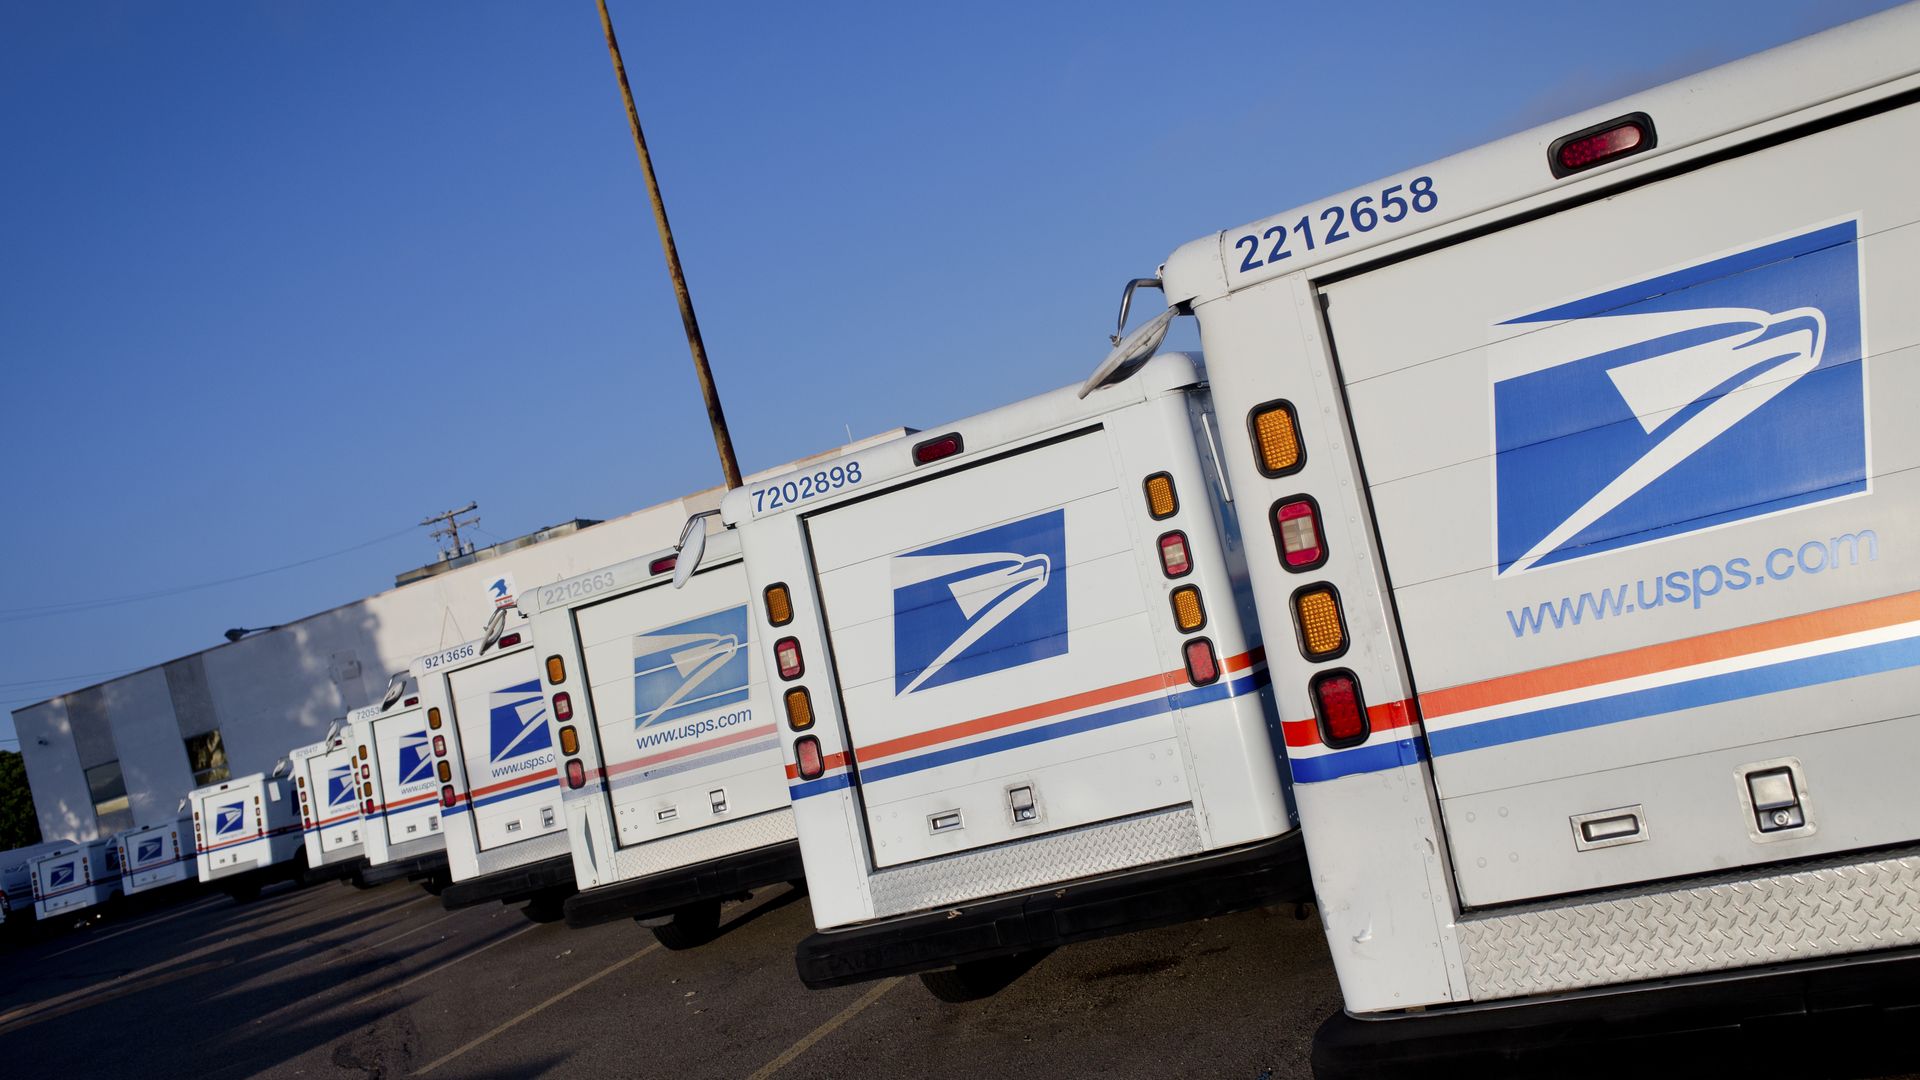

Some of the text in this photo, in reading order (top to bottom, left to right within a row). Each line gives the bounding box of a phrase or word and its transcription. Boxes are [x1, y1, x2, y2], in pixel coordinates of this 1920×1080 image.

[1235, 176, 1438, 273] 2212658
[752, 461, 862, 512] 7202898
[544, 572, 615, 606] 2212663
[1506, 529, 1879, 638] www.usps.com
[425, 645, 474, 669] 9213656
[636, 709, 752, 749] www.usps.com
